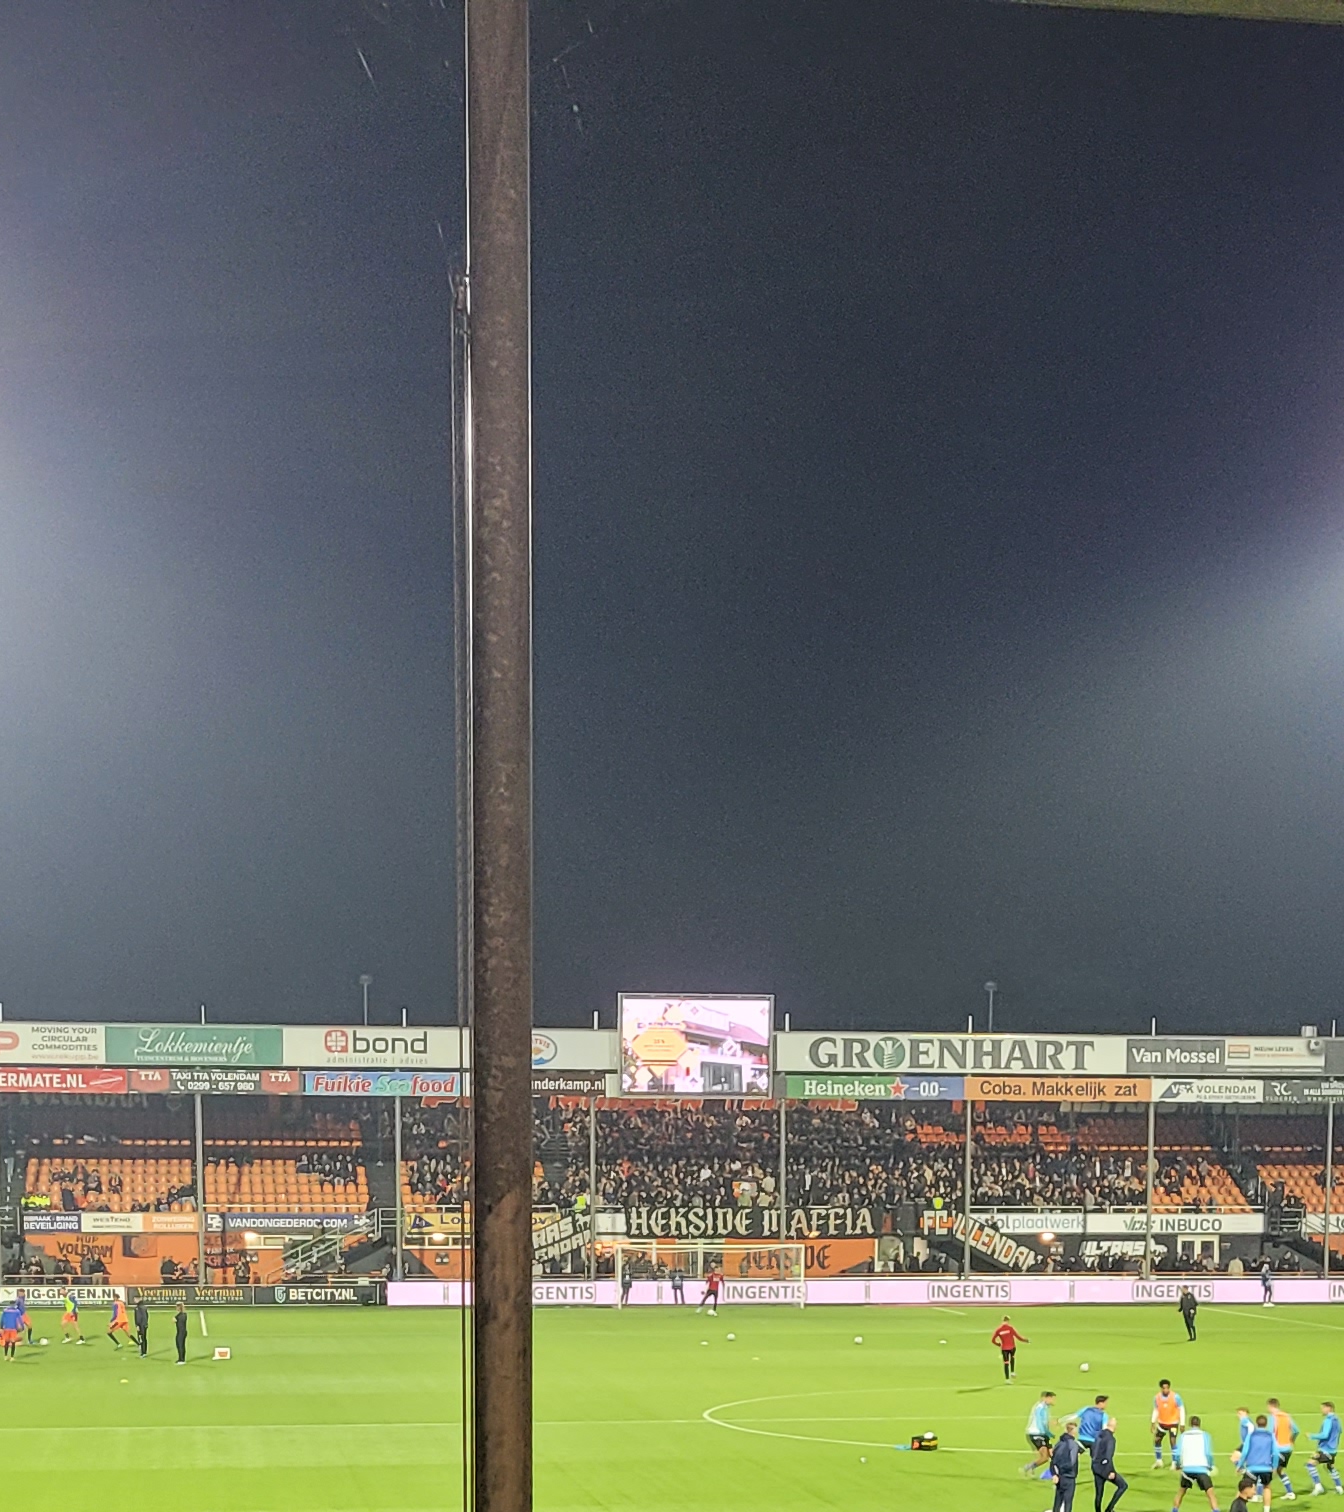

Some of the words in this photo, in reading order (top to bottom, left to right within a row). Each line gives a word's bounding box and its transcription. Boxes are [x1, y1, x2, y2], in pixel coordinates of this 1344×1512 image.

[31, 1026, 69, 1034] MOVING
[71, 1026, 97, 1034] YOUR
[41, 1035, 87, 1043] CIRCULAR
[135, 1028, 253, 1062] Lokkemientje
[353, 1030, 428, 1054] bond
[31, 1043, 97, 1051] COMMODITIES
[809, 1036, 1094, 1070] GROENHART
[326, 1056, 388, 1064] administratie
[399, 1057, 428, 1065] advies
[1132, 1048, 1162, 1063] Van
[1166, 1048, 1220, 1063] Mossel
[139, 1071, 161, 1081] TTA
[171, 1072, 191, 1080] TAXI
[193, 1073, 209, 1081] TTA
[211, 1073, 259, 1081] VOLENDAM
[269, 1072, 291, 1082] TTA
[313, 1076, 372, 1093] Fuikie
[804, 1080, 885, 1097] Heineken
[980, 1081, 1026, 1096] Coba.
[1031, 1081, 1106, 1101] Makkelijk
[1114, 1083, 1138, 1097] zat
[1171, 1083, 1194, 1094] VSK
[1197, 1085, 1256, 1094] VOLENDAM
[1271, 1082, 1292, 1096] RC
[24, 1222, 78, 1231] BEVEILIGING
[629, 1205, 754, 1237] HEKSIDE
[762, 1206, 875, 1239] MAFFIA
[922, 1209, 949, 1236] FC
[1013, 1215, 1084, 1233] plaatwerk
[1160, 1219, 1222, 1232] INBUCO
[76, 1235, 99, 1243] HUP
[57, 1242, 113, 1257] VOLENDAM
[138, 1287, 186, 1297] Veerman
[194, 1287, 243, 1297] Veerman
[289, 1289, 357, 1301] BETCITY.NL
[533, 1286, 594, 1300] GENTIS
[931, 1284, 1009, 1299] INGENTIS
